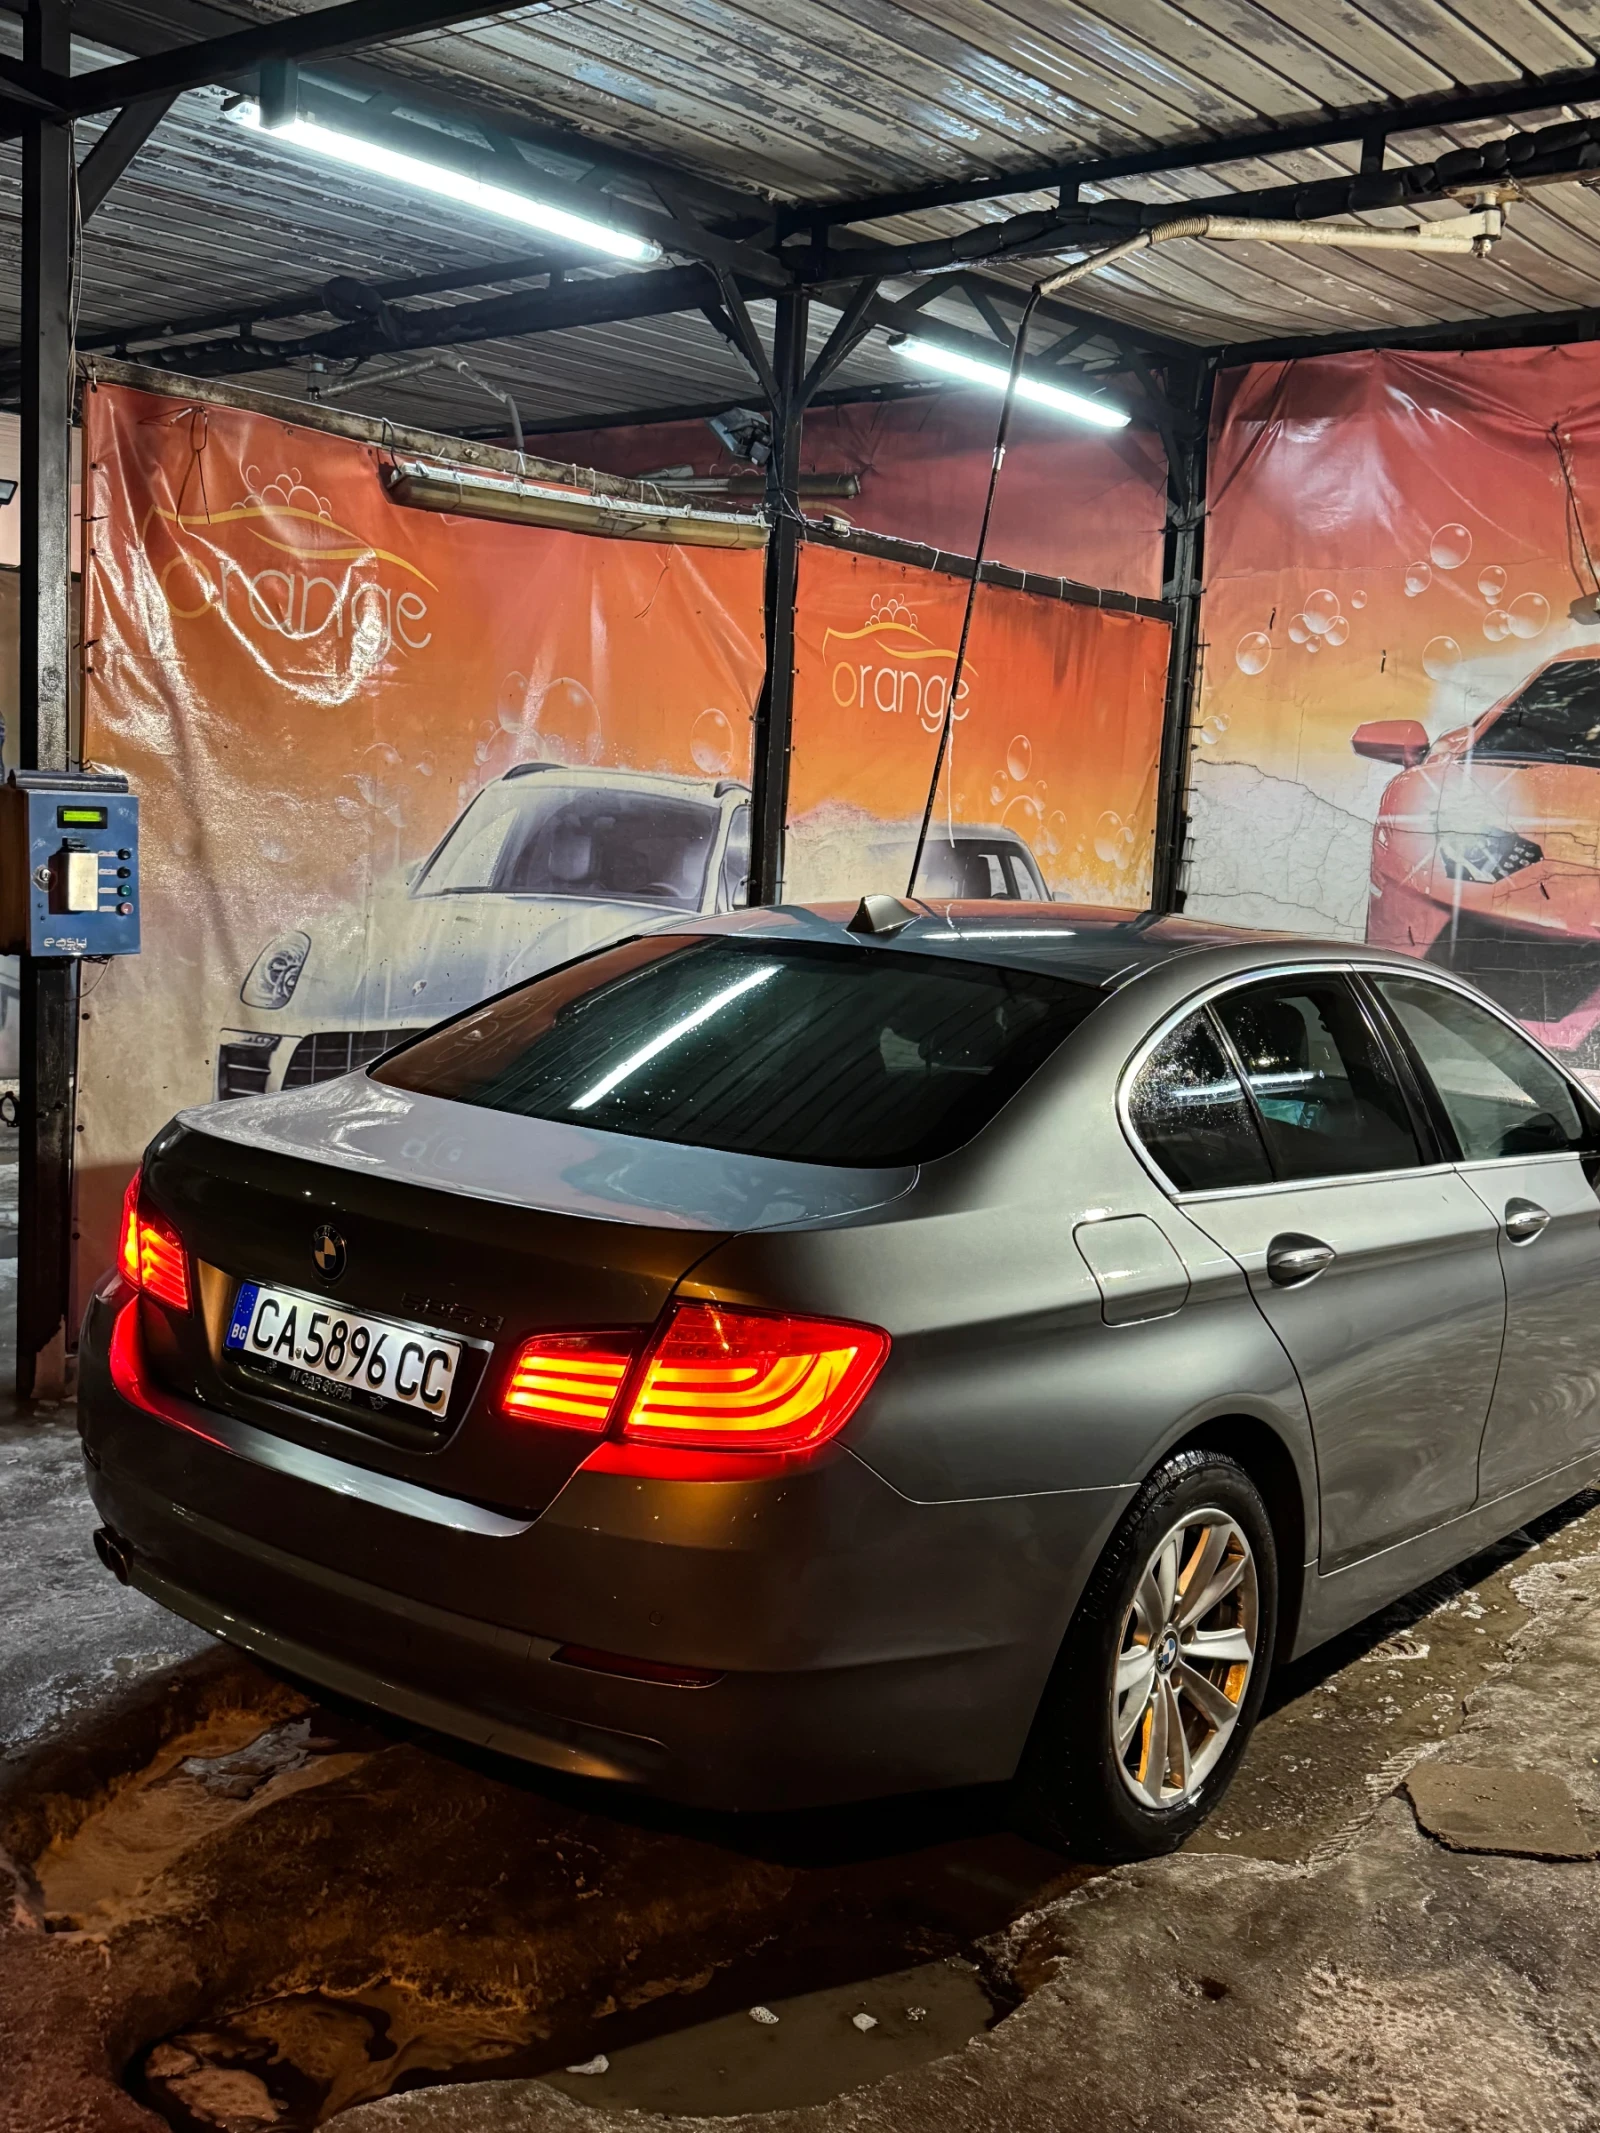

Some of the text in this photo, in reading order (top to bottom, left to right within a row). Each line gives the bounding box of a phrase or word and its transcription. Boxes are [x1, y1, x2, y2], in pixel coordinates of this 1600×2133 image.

[160, 555, 432, 664] orange
[832, 661, 970, 733] orange
[231, 1323, 248, 1341] BG
[301, 1372, 322, 1391] CAR
[322, 1380, 352, 1400] SOFIA
